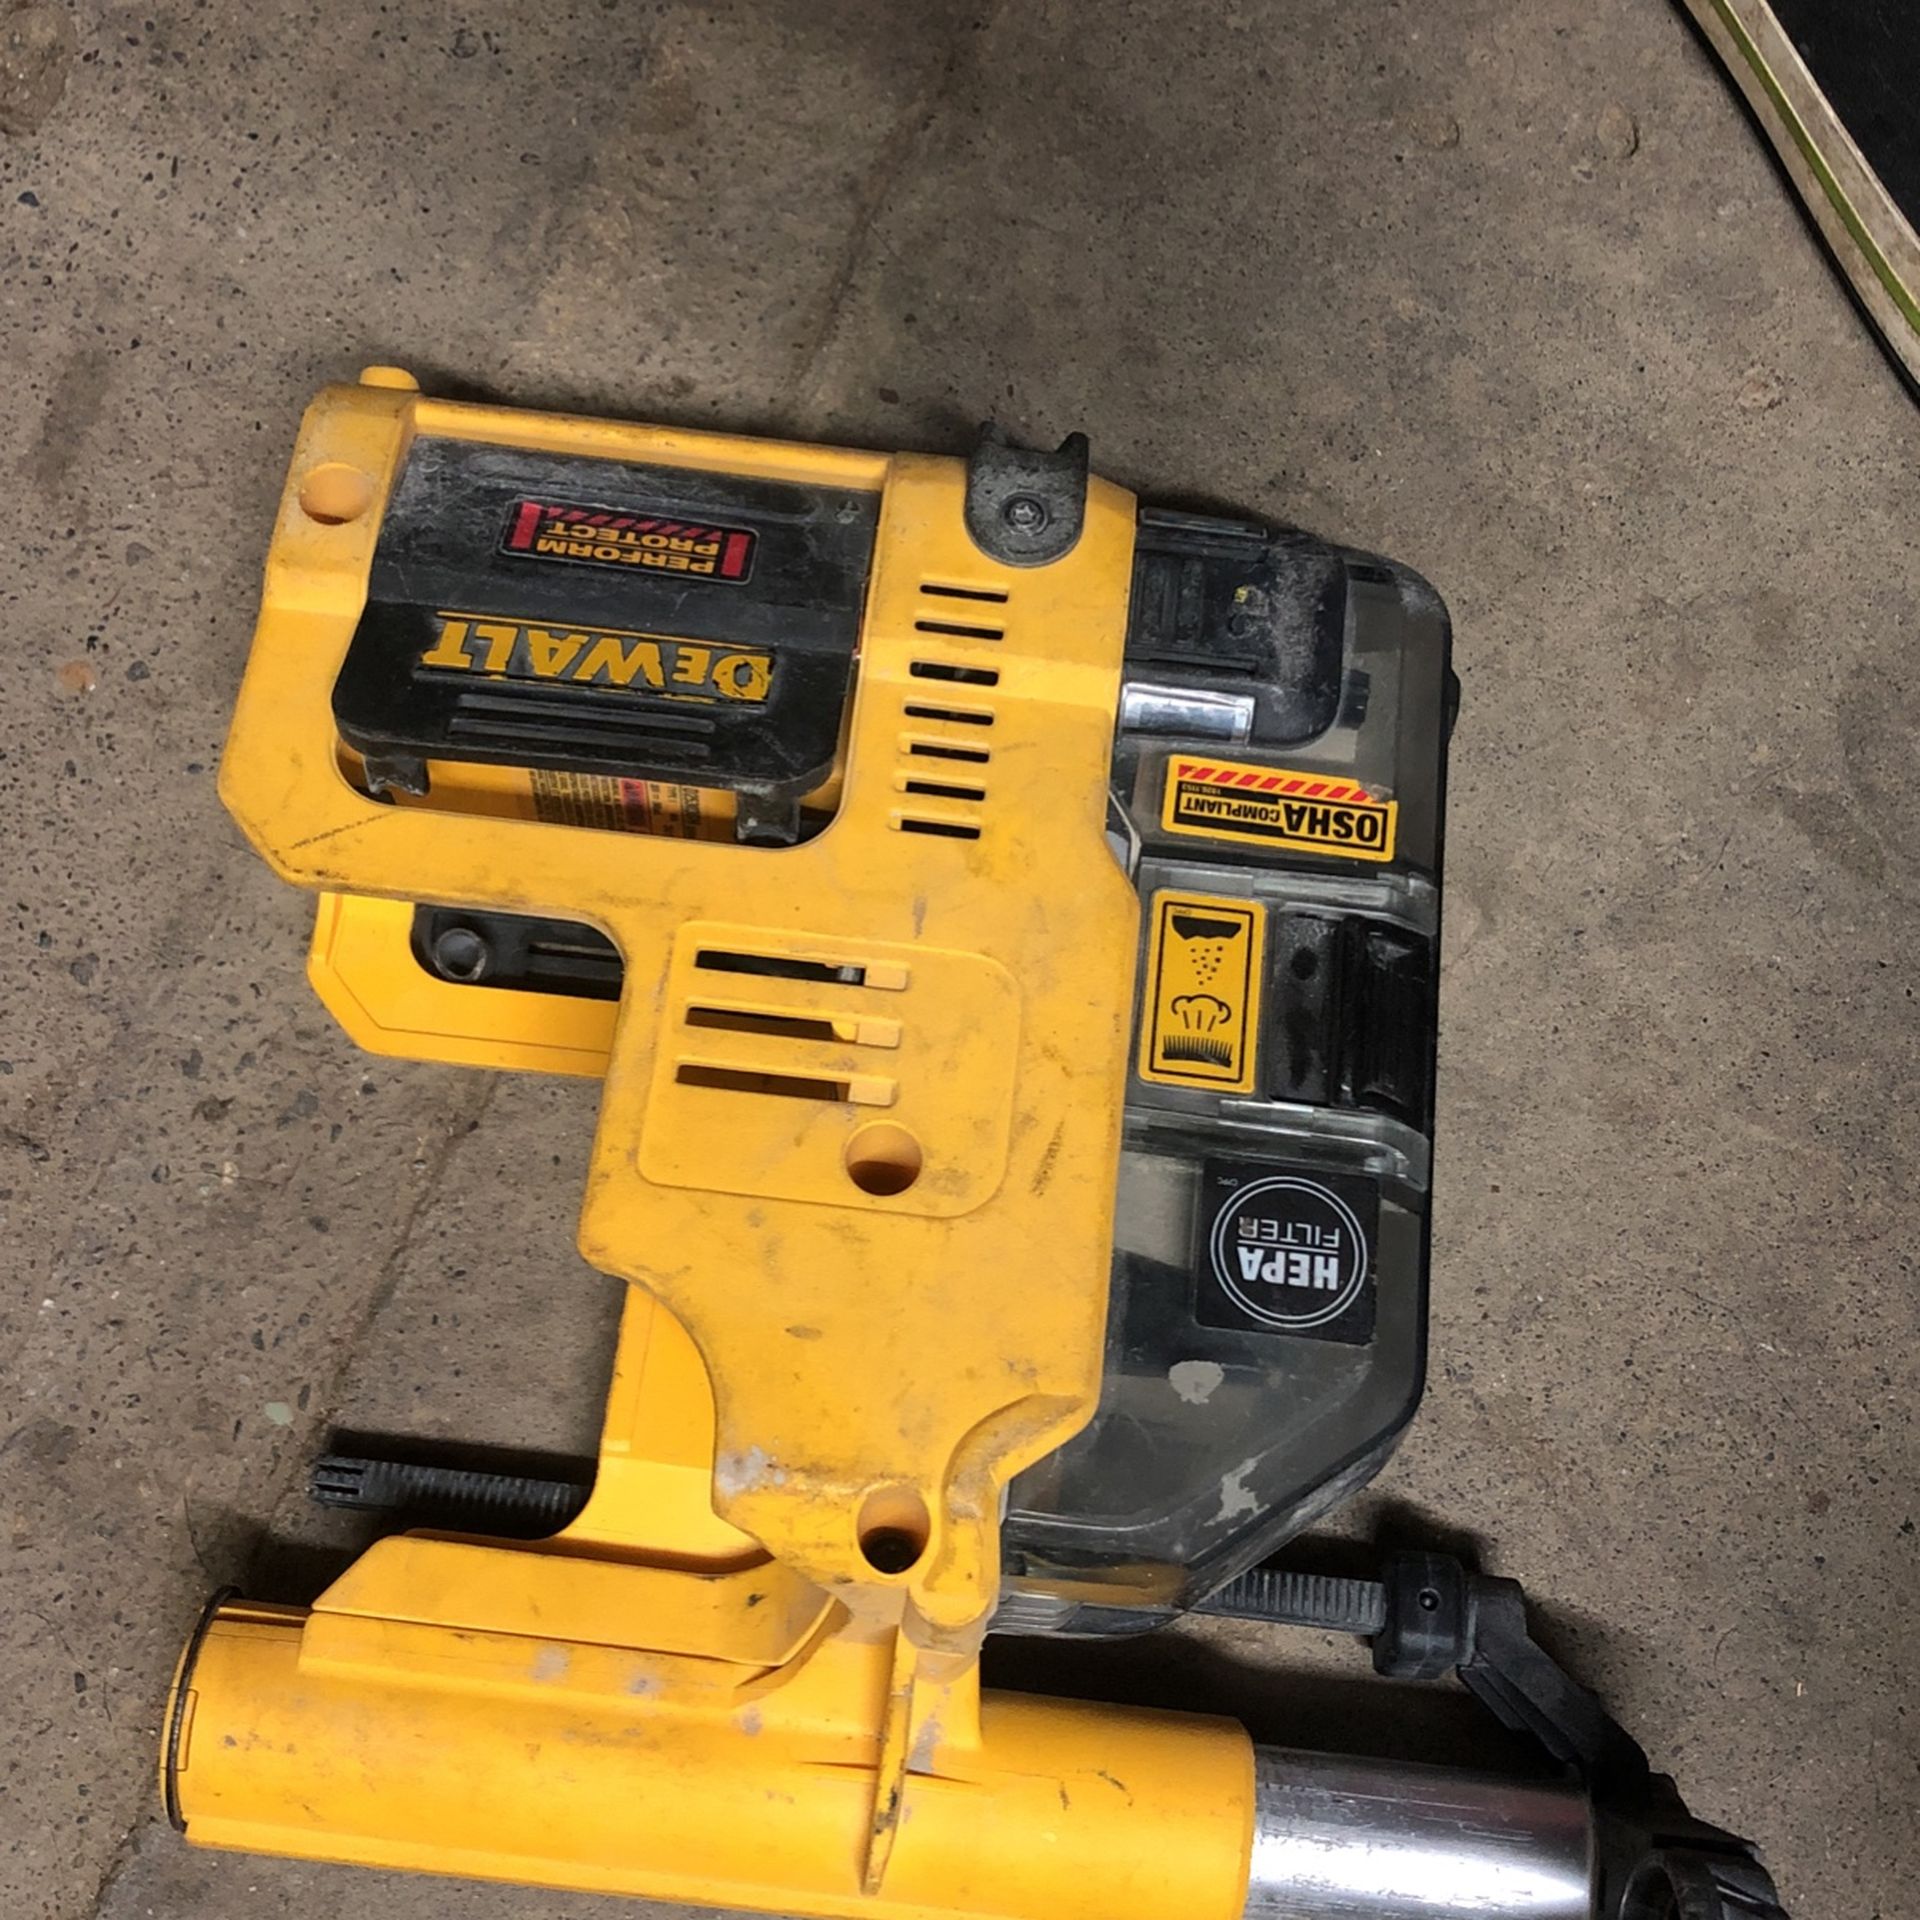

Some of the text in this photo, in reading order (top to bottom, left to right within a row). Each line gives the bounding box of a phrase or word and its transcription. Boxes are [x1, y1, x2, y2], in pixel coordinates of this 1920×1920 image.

[536, 537, 715, 575] PERFORM
[545, 521, 720, 556] PROTECT
[421, 620, 774, 701] DEWALT
[1183, 796, 1379, 843] OSHA COMPLIANT
[1238, 1216, 1340, 1248] FILTER
[1237, 1246, 1338, 1290] HEPA
